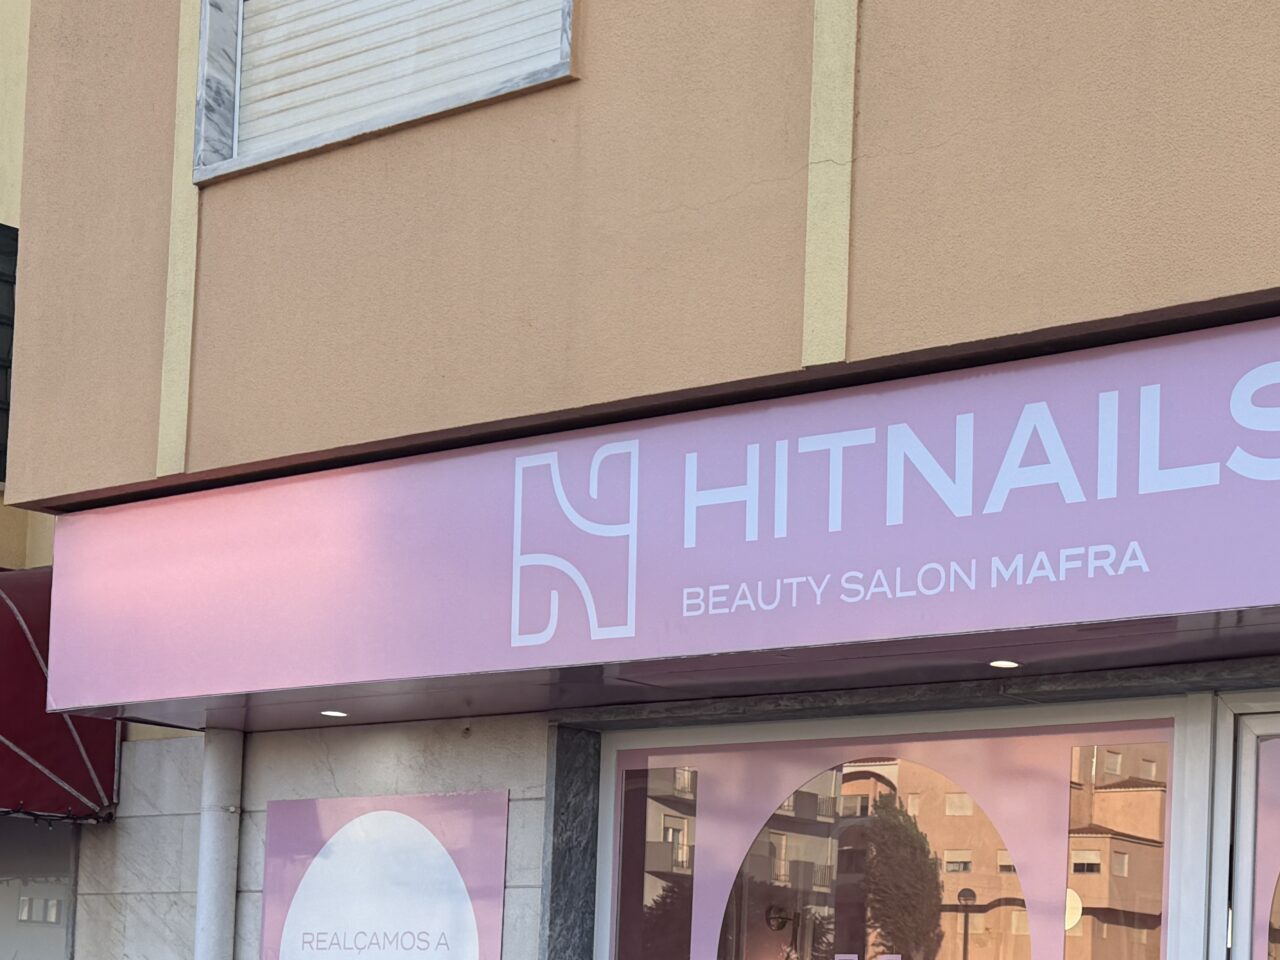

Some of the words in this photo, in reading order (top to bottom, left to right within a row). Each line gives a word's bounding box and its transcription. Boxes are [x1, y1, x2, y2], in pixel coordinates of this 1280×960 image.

[682, 574, 830, 617] BEAUTY
[840, 558, 977, 604] SALON
[989, 540, 1150, 589] MAFRA
[301, 931, 430, 955] REALÇAMOS
[435, 931, 450, 951] A
